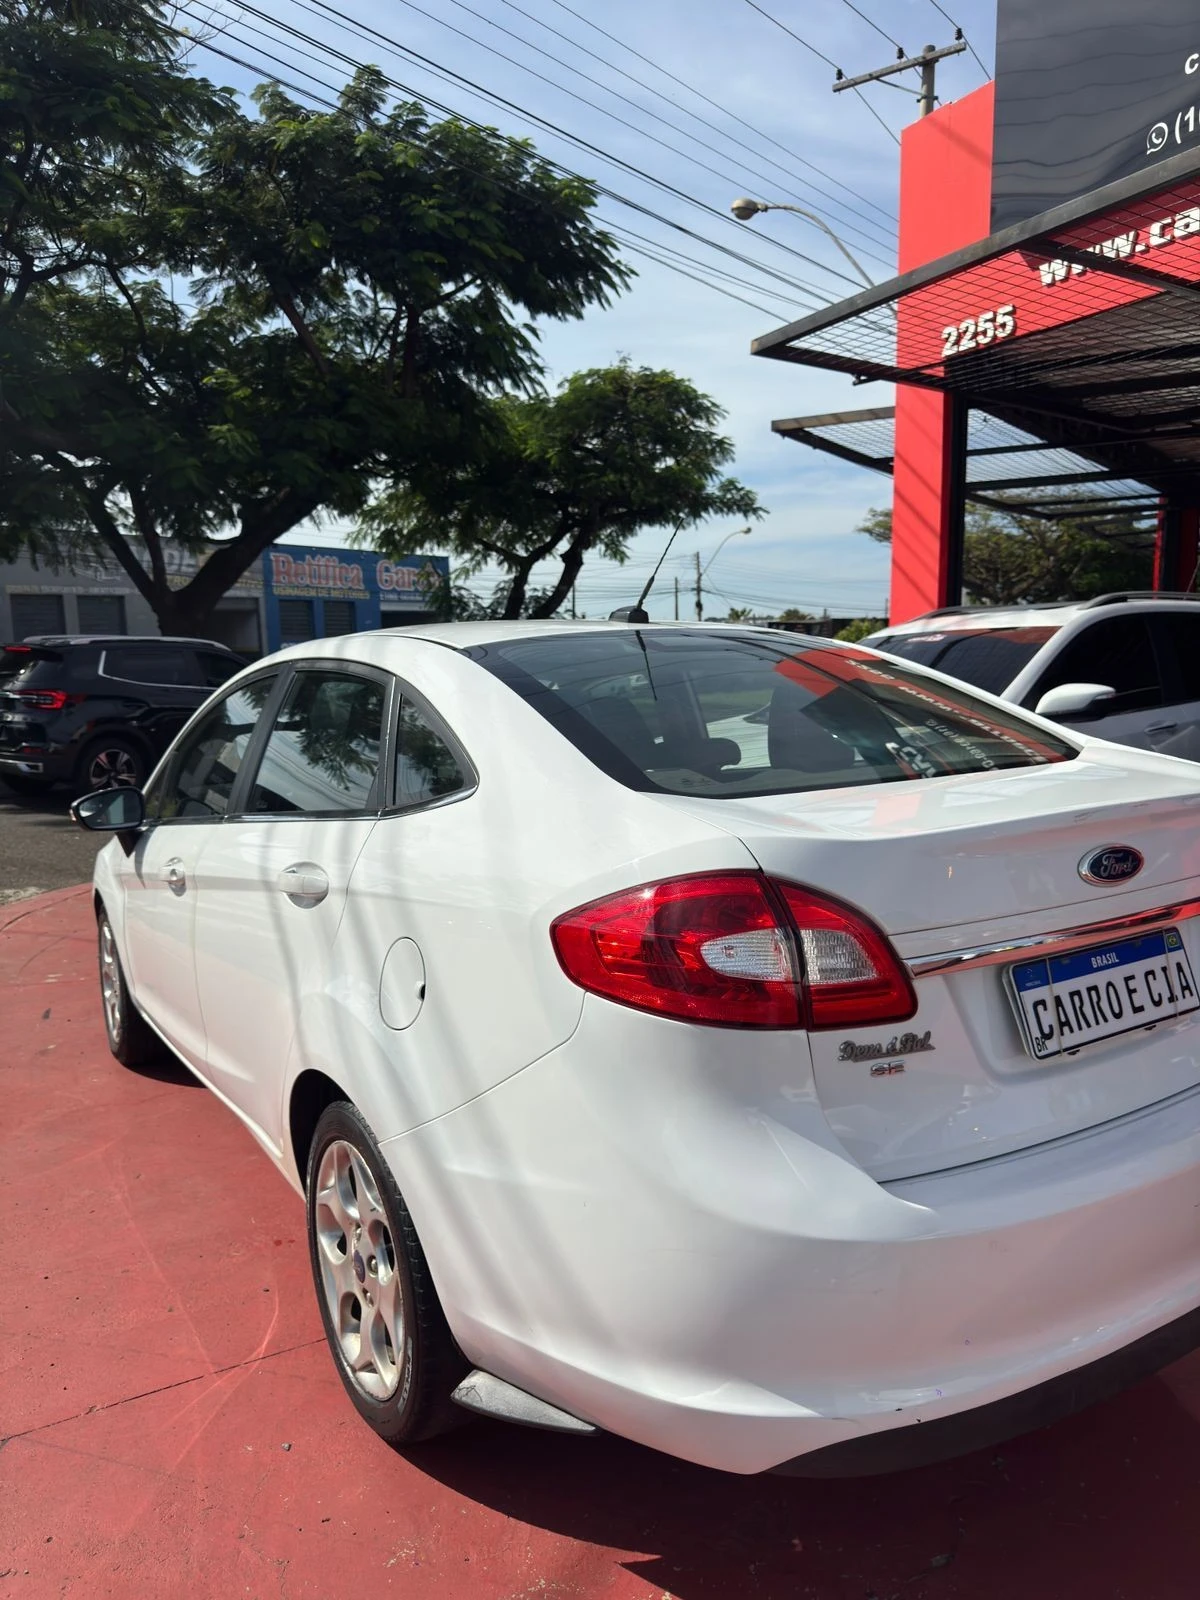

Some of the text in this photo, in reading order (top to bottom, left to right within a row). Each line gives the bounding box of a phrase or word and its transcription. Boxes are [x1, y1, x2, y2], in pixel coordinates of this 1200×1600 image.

[1174, 105, 1200, 144] (1
[941, 304, 1016, 357] 2255
[1100, 853, 1136, 877] Ford
[1091, 952, 1120, 968] BRASIL
[1035, 1035, 1049, 1053] BR
